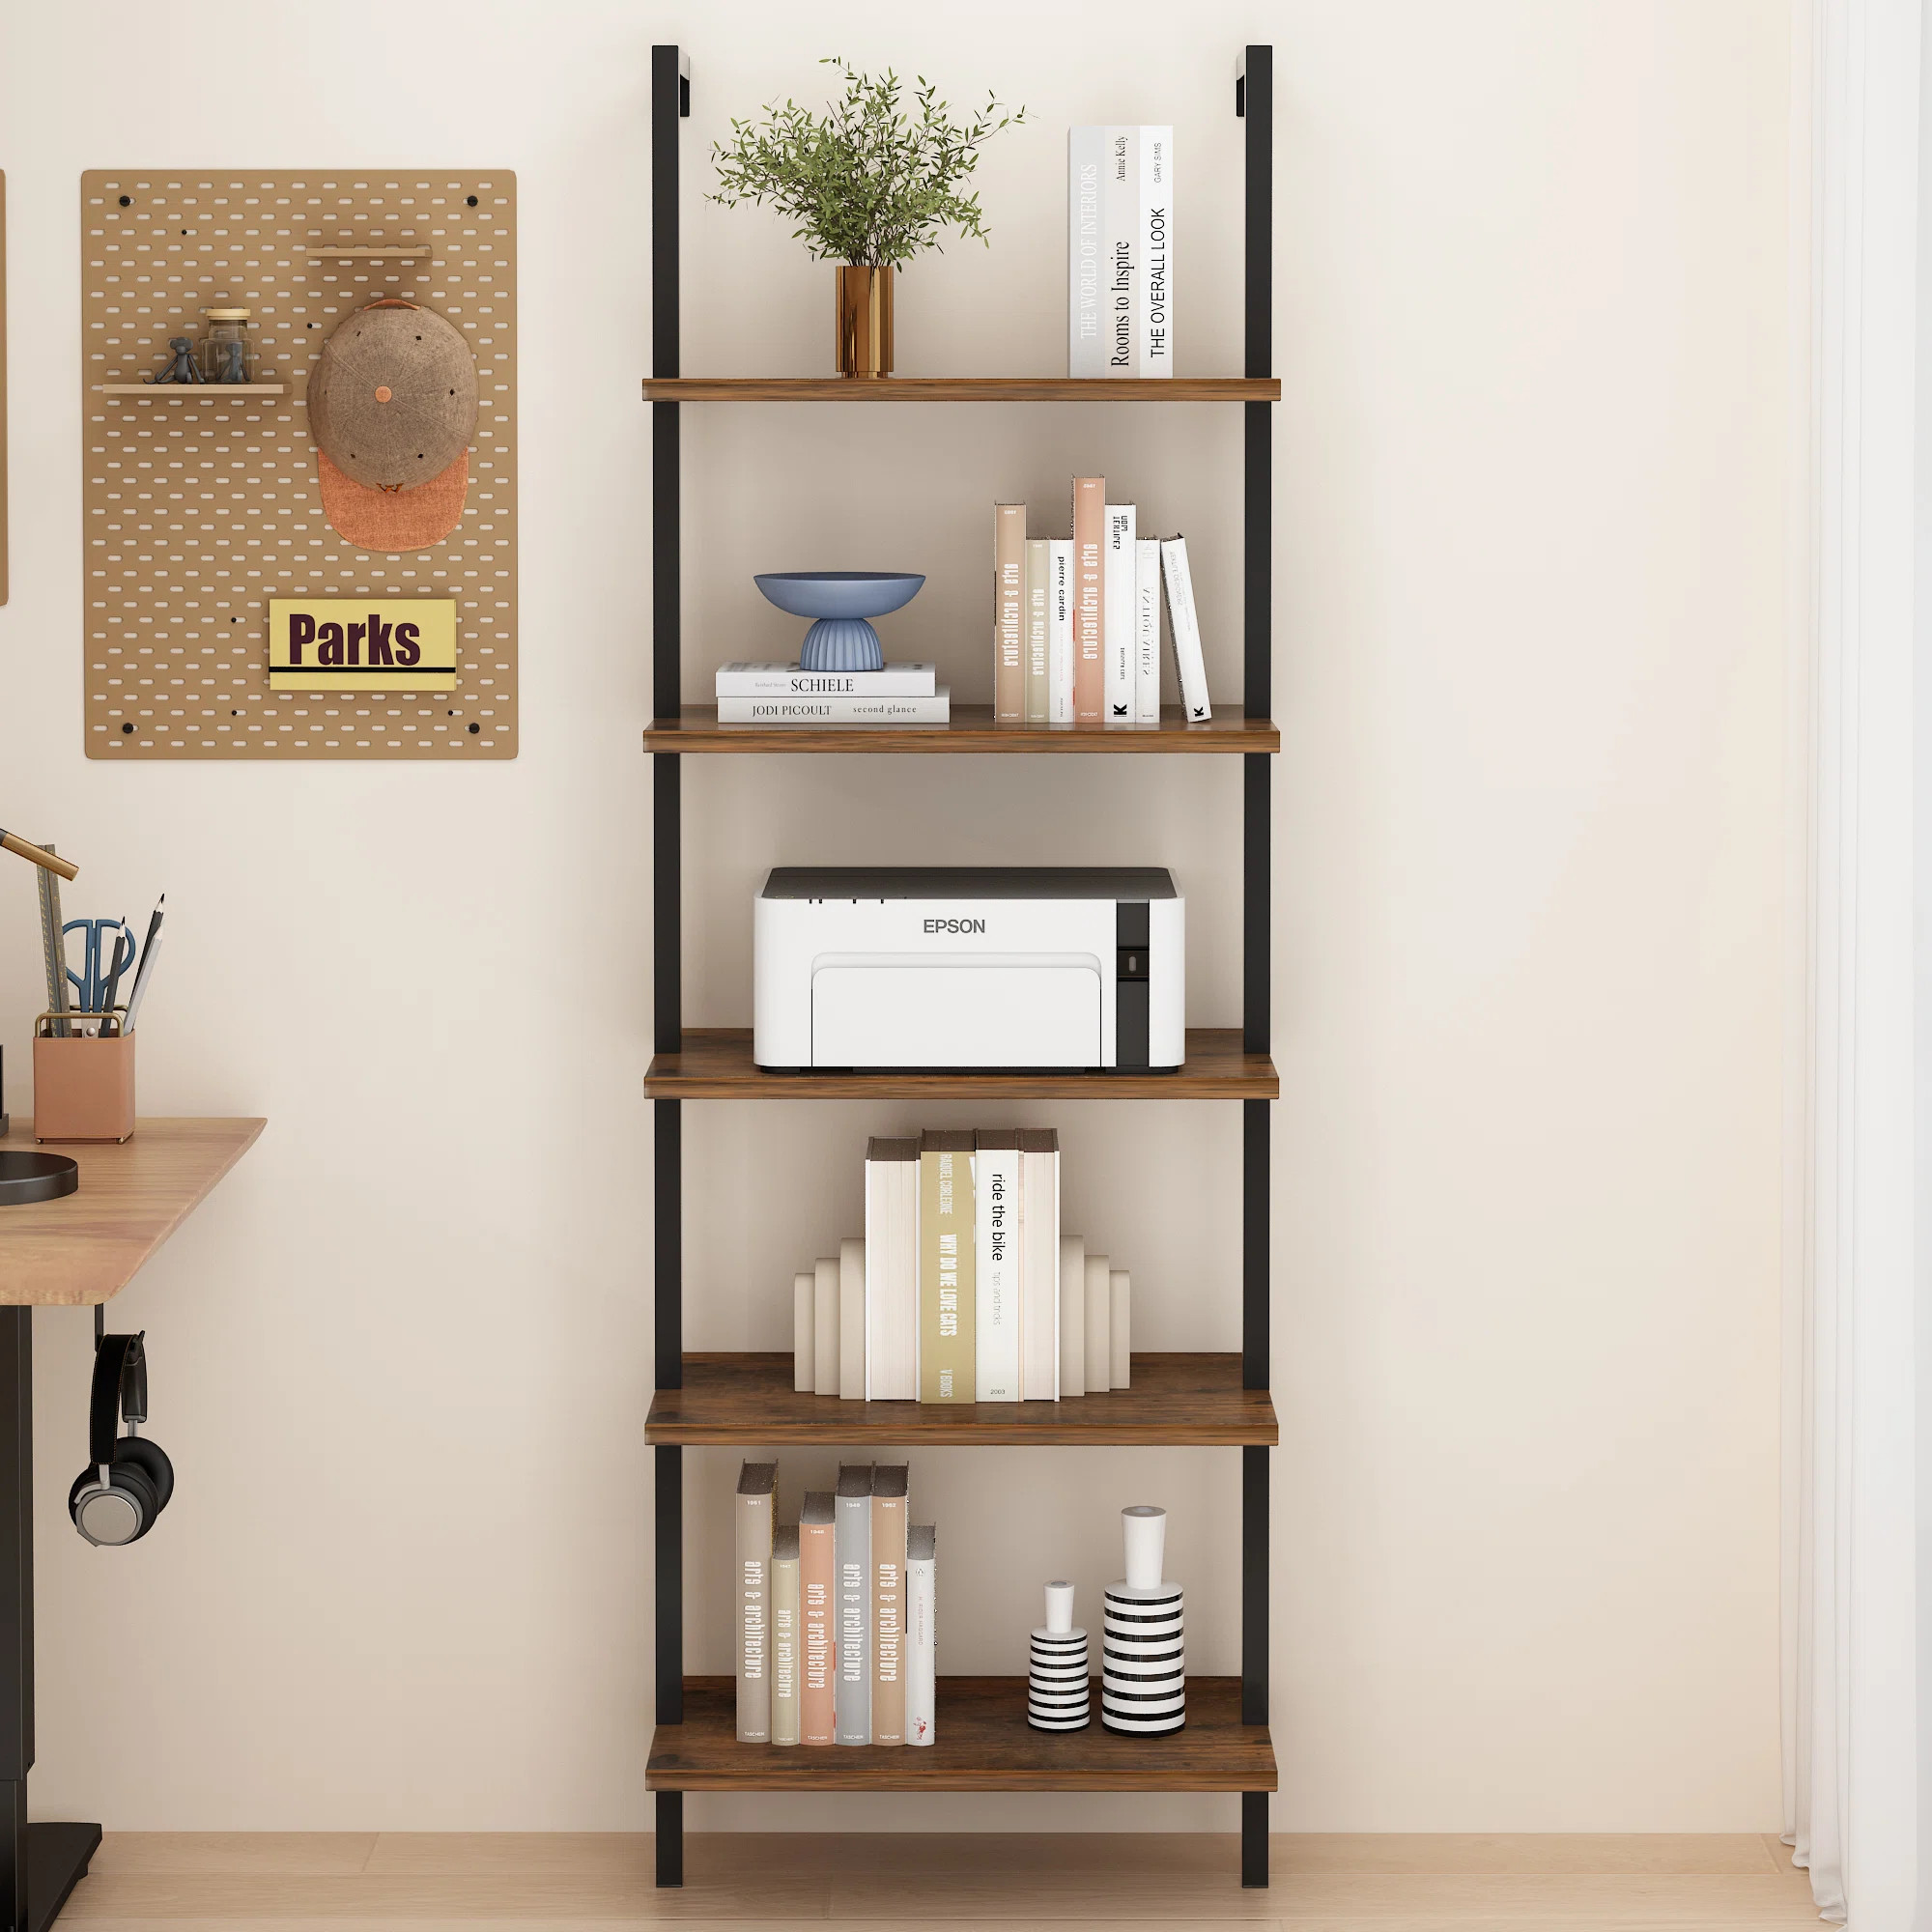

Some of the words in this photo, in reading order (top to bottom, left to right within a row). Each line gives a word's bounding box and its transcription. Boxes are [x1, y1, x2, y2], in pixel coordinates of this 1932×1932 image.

[1116, 136, 1128, 157] Kelly
[1116, 158, 1125, 182] Annie
[1081, 164, 1097, 235] INTERIORS
[1151, 208, 1165, 250] LOOK
[1081, 240, 1097, 256] OF
[1110, 242, 1134, 291] Inspire
[1081, 259, 1097, 308] WORLD
[1151, 254, 1165, 324] OVERALL
[1115, 297, 1129, 310] to
[1081, 311, 1097, 339] THE
[1111, 315, 1129, 367] Rooms
[1151, 328, 1165, 357] THE
[1058, 589, 1066, 621] cardin
[290, 614, 421, 666] Parks
[791, 679, 854, 693] SCHIELE
[753, 705, 778, 717] JODI
[781, 705, 832, 716] PICOULT
[853, 704, 885, 714] second
[887, 704, 917, 715] glance
[923, 919, 985, 933] EPSON
[940, 1153, 952, 1179] RAQUEL
[940, 1180, 952, 1214] CORLEONE
[992, 1174, 1006, 1201] ride
[992, 1205, 1006, 1228] the
[940, 1234, 957, 1255] WHY
[992, 1232, 1006, 1262] bike
[940, 1257, 957, 1270] DO
[940, 1272, 957, 1287] WE
[940, 1289, 957, 1311] LOVE
[940, 1313, 957, 1337] CATS
[940, 1375, 953, 1398] BOOKS
[744, 1561, 764, 1585] arts
[842, 1564, 863, 1588] arts
[879, 1564, 899, 1588] arts
[744, 1591, 762, 1600] &
[808, 1583, 827, 1605] arts
[842, 1594, 861, 1603] &
[879, 1594, 897, 1603] &
[778, 1609, 793, 1628] arts
[808, 1610, 825, 1619] &
[744, 1605, 765, 1679] architecture
[842, 1607, 865, 1682] architecture
[879, 1607, 900, 1682] architecture
[808, 1623, 829, 1689] architecture
[778, 1642, 794, 1698] architecture
